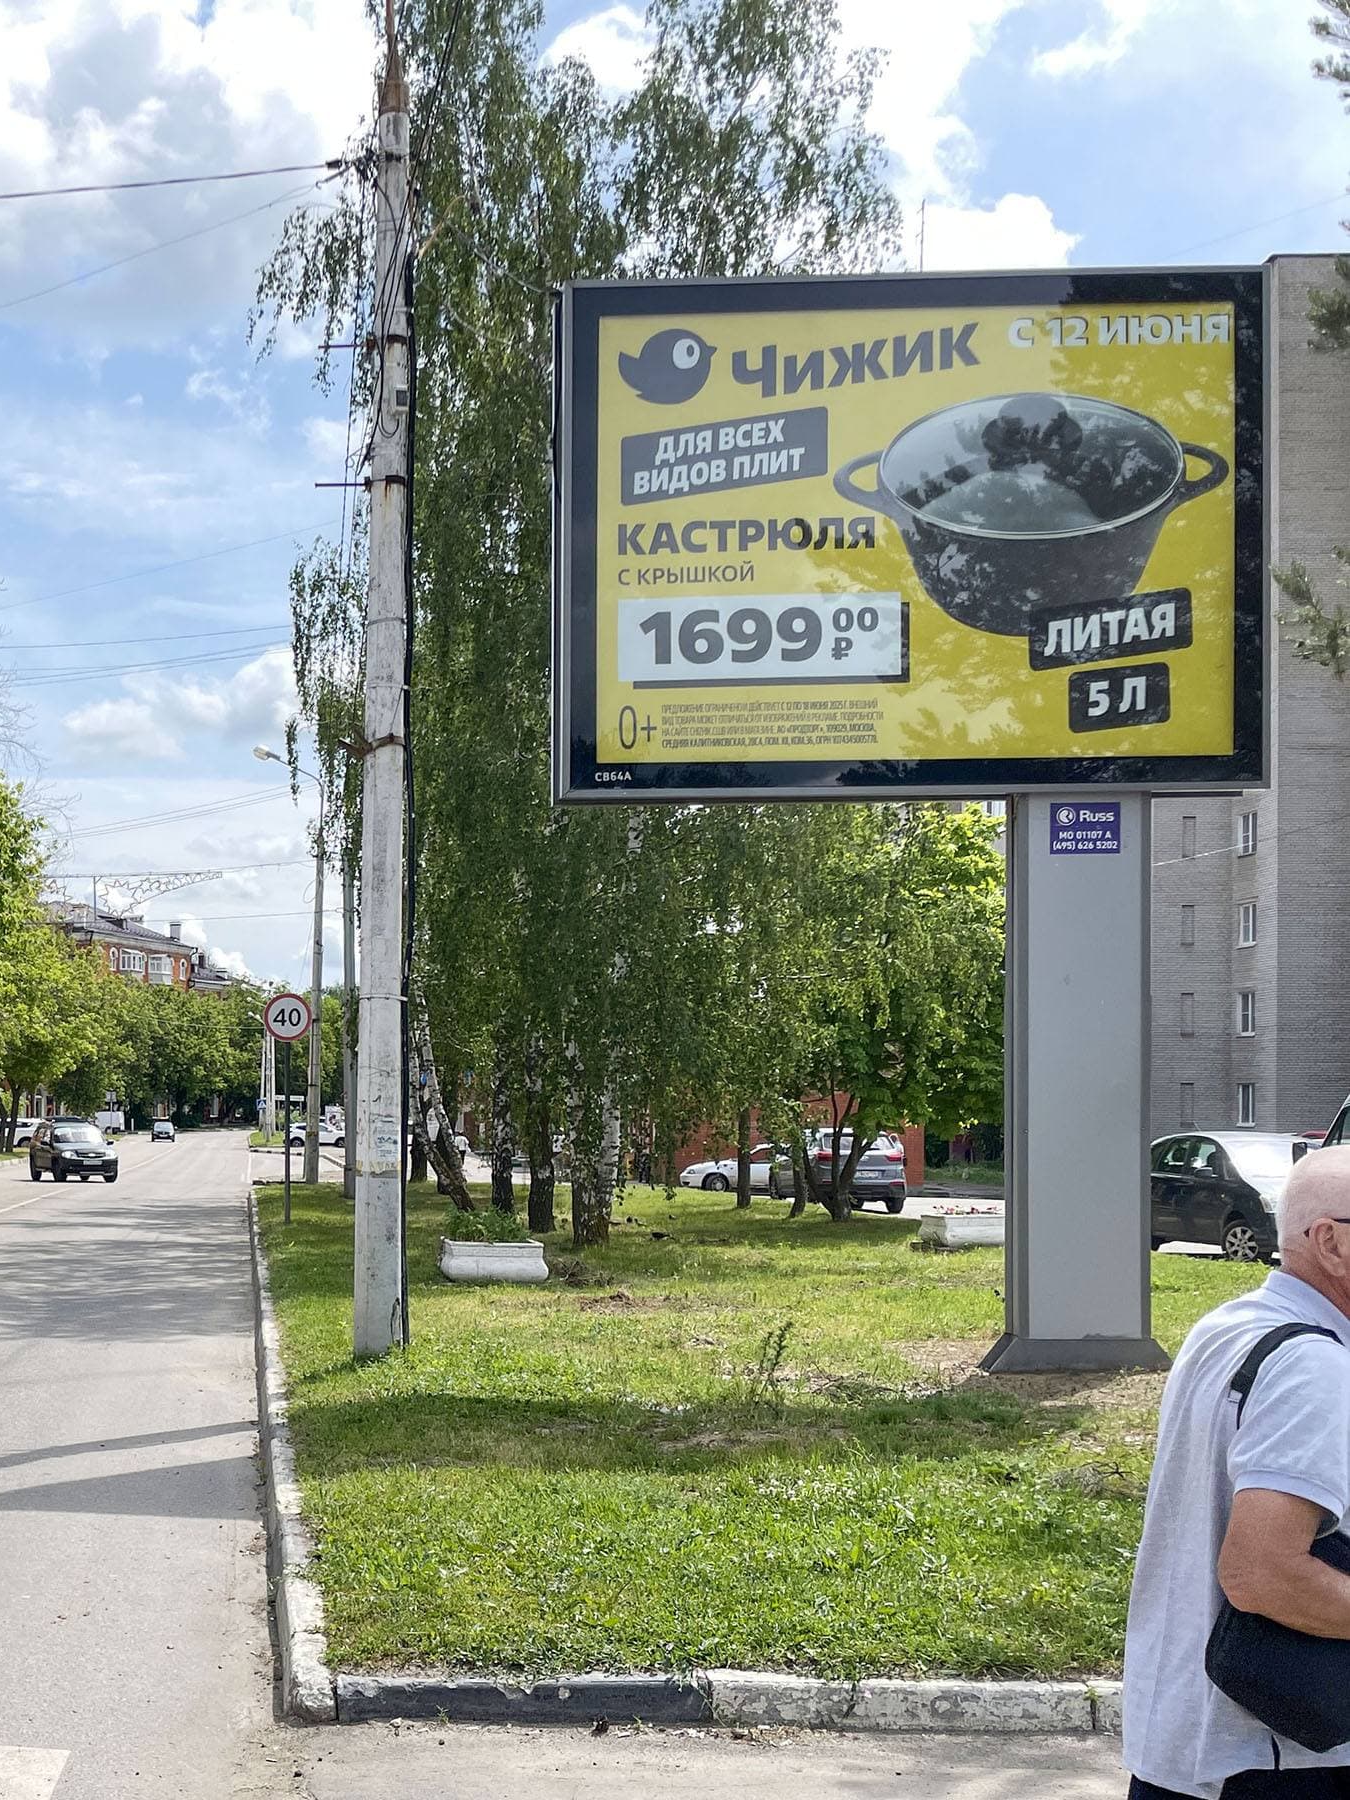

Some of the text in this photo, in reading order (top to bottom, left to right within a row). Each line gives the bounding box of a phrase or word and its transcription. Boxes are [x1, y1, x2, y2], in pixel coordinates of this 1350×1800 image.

[1007, 314, 1231, 348] С 12 ИЮНЯ
[654, 418, 787, 465] ДЛЯ ВСЕХ
[633, 447, 806, 497] ВИДОВ ПЛИТ
[617, 516, 876, 556] КАСТРЮЛЯ
[617, 560, 755, 586] С КРЫШКОЙ
[639, 606, 880, 665] 1699 00
[1043, 602, 1176, 657] ЛИТАЯ
[1087, 676, 1147, 717] 5 Л
[618, 705, 658, 750] 0+
[1076, 831, 1103, 840] 01107
[1079, 810, 1115, 822] Russ
[1053, 841, 1118, 851] (495) 626 5202
[272, 1007, 302, 1027] 40
